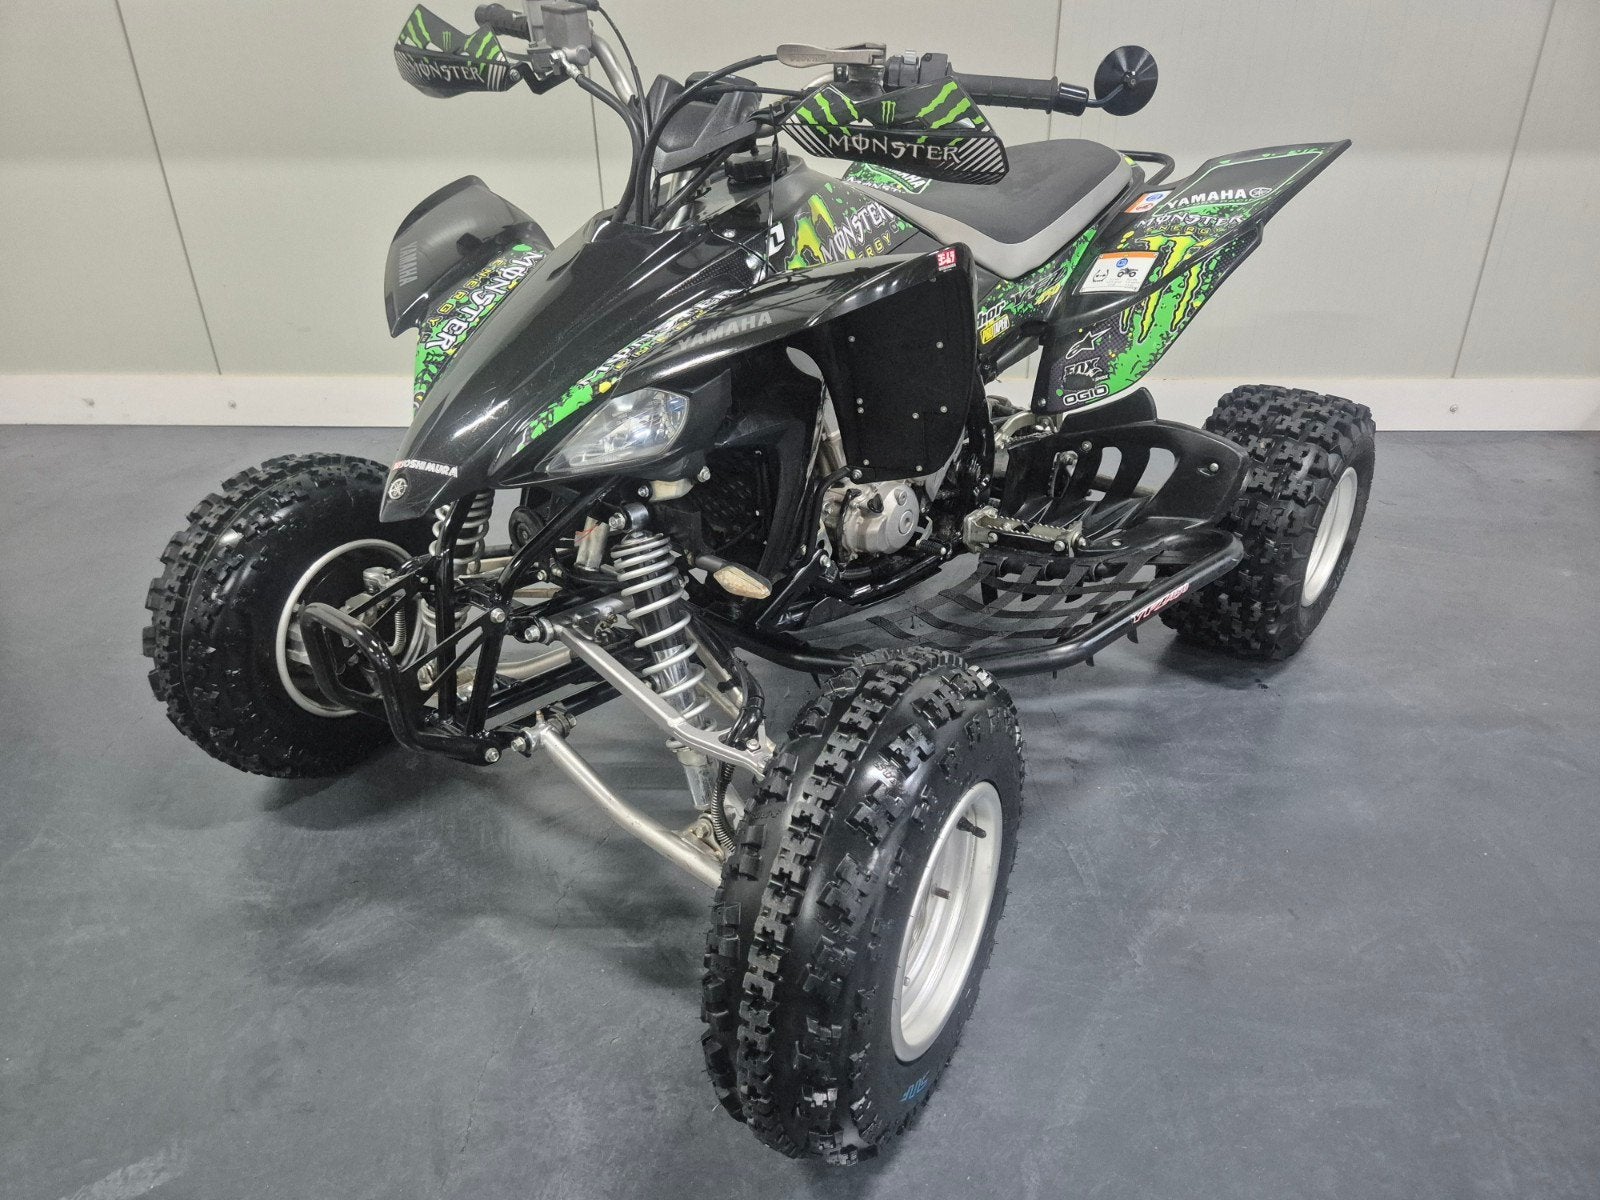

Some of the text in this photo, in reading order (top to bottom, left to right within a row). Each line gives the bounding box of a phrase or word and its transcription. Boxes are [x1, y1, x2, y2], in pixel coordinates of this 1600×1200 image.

[406, 55, 485, 83] MONSTER
[828, 133, 962, 164] MONSTER
[1165, 188, 1247, 209] YAMAHA
[1135, 212, 1247, 229] MONSTER
[399, 241, 418, 287] YAMAHA
[424, 250, 544, 350] MONSTER
[976, 300, 1006, 330] hor
[679, 311, 773, 350] YAMAHA
[1063, 384, 1109, 406] OGIO
